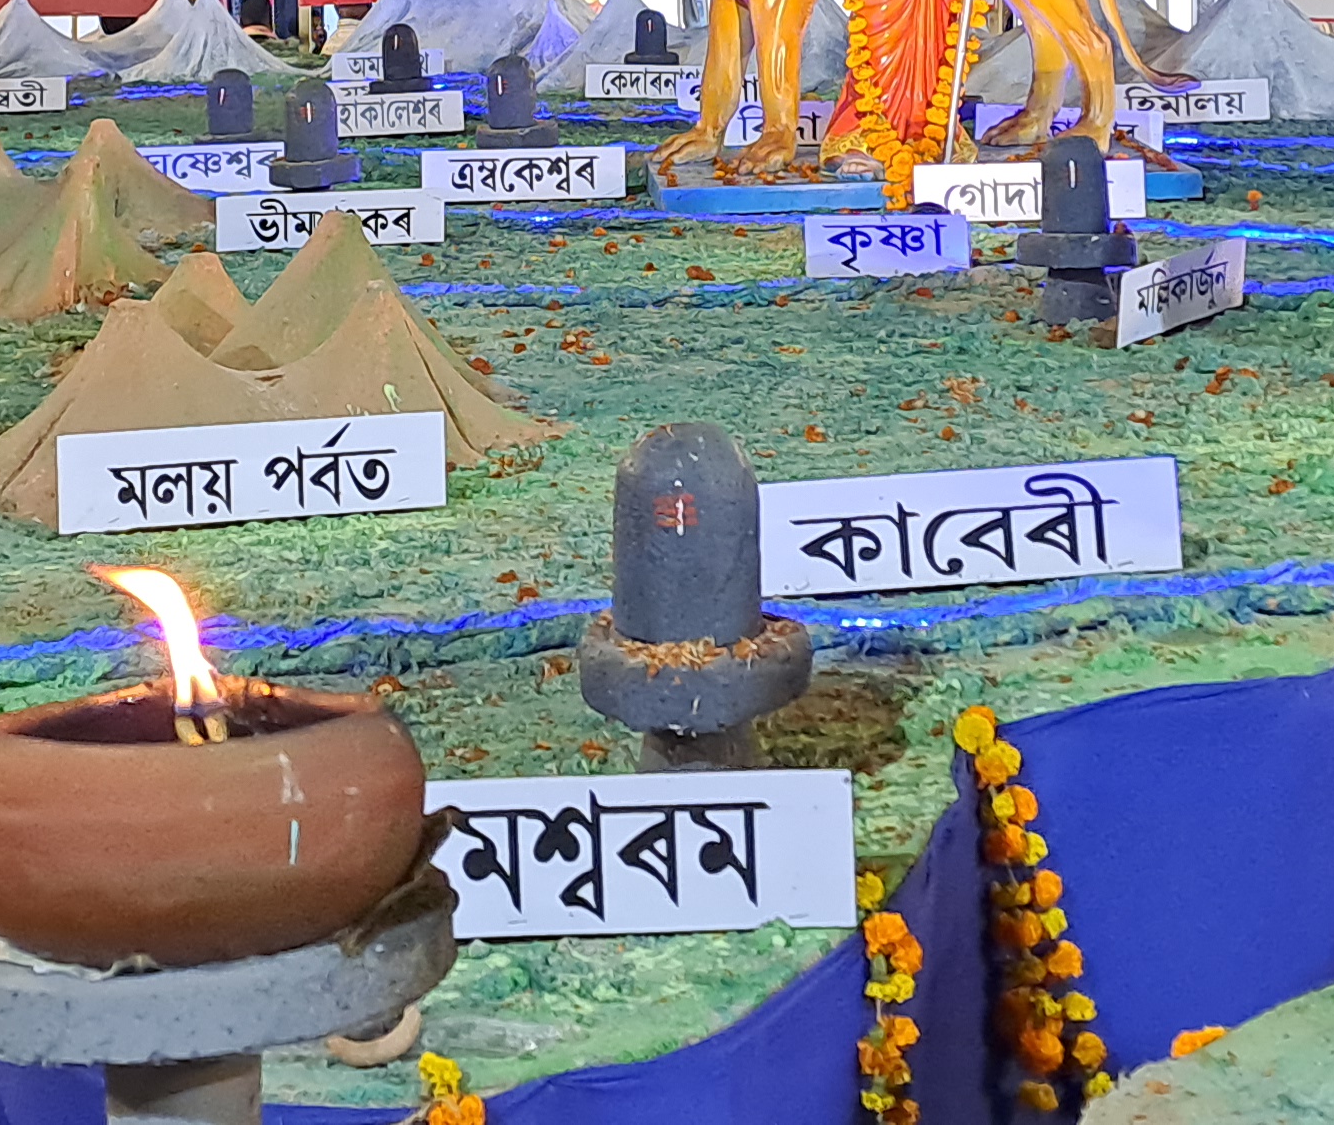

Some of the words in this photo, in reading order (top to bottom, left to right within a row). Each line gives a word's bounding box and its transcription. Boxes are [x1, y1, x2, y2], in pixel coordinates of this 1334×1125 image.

[337, 95, 443, 132] হাকালেশ্বৰ
[823, 217, 948, 274] কৃষ্ণা
[108, 458, 239, 520] মলয়
[263, 422, 398, 509] পৰ্বত
[789, 472, 1120, 582] কাবেৰী
